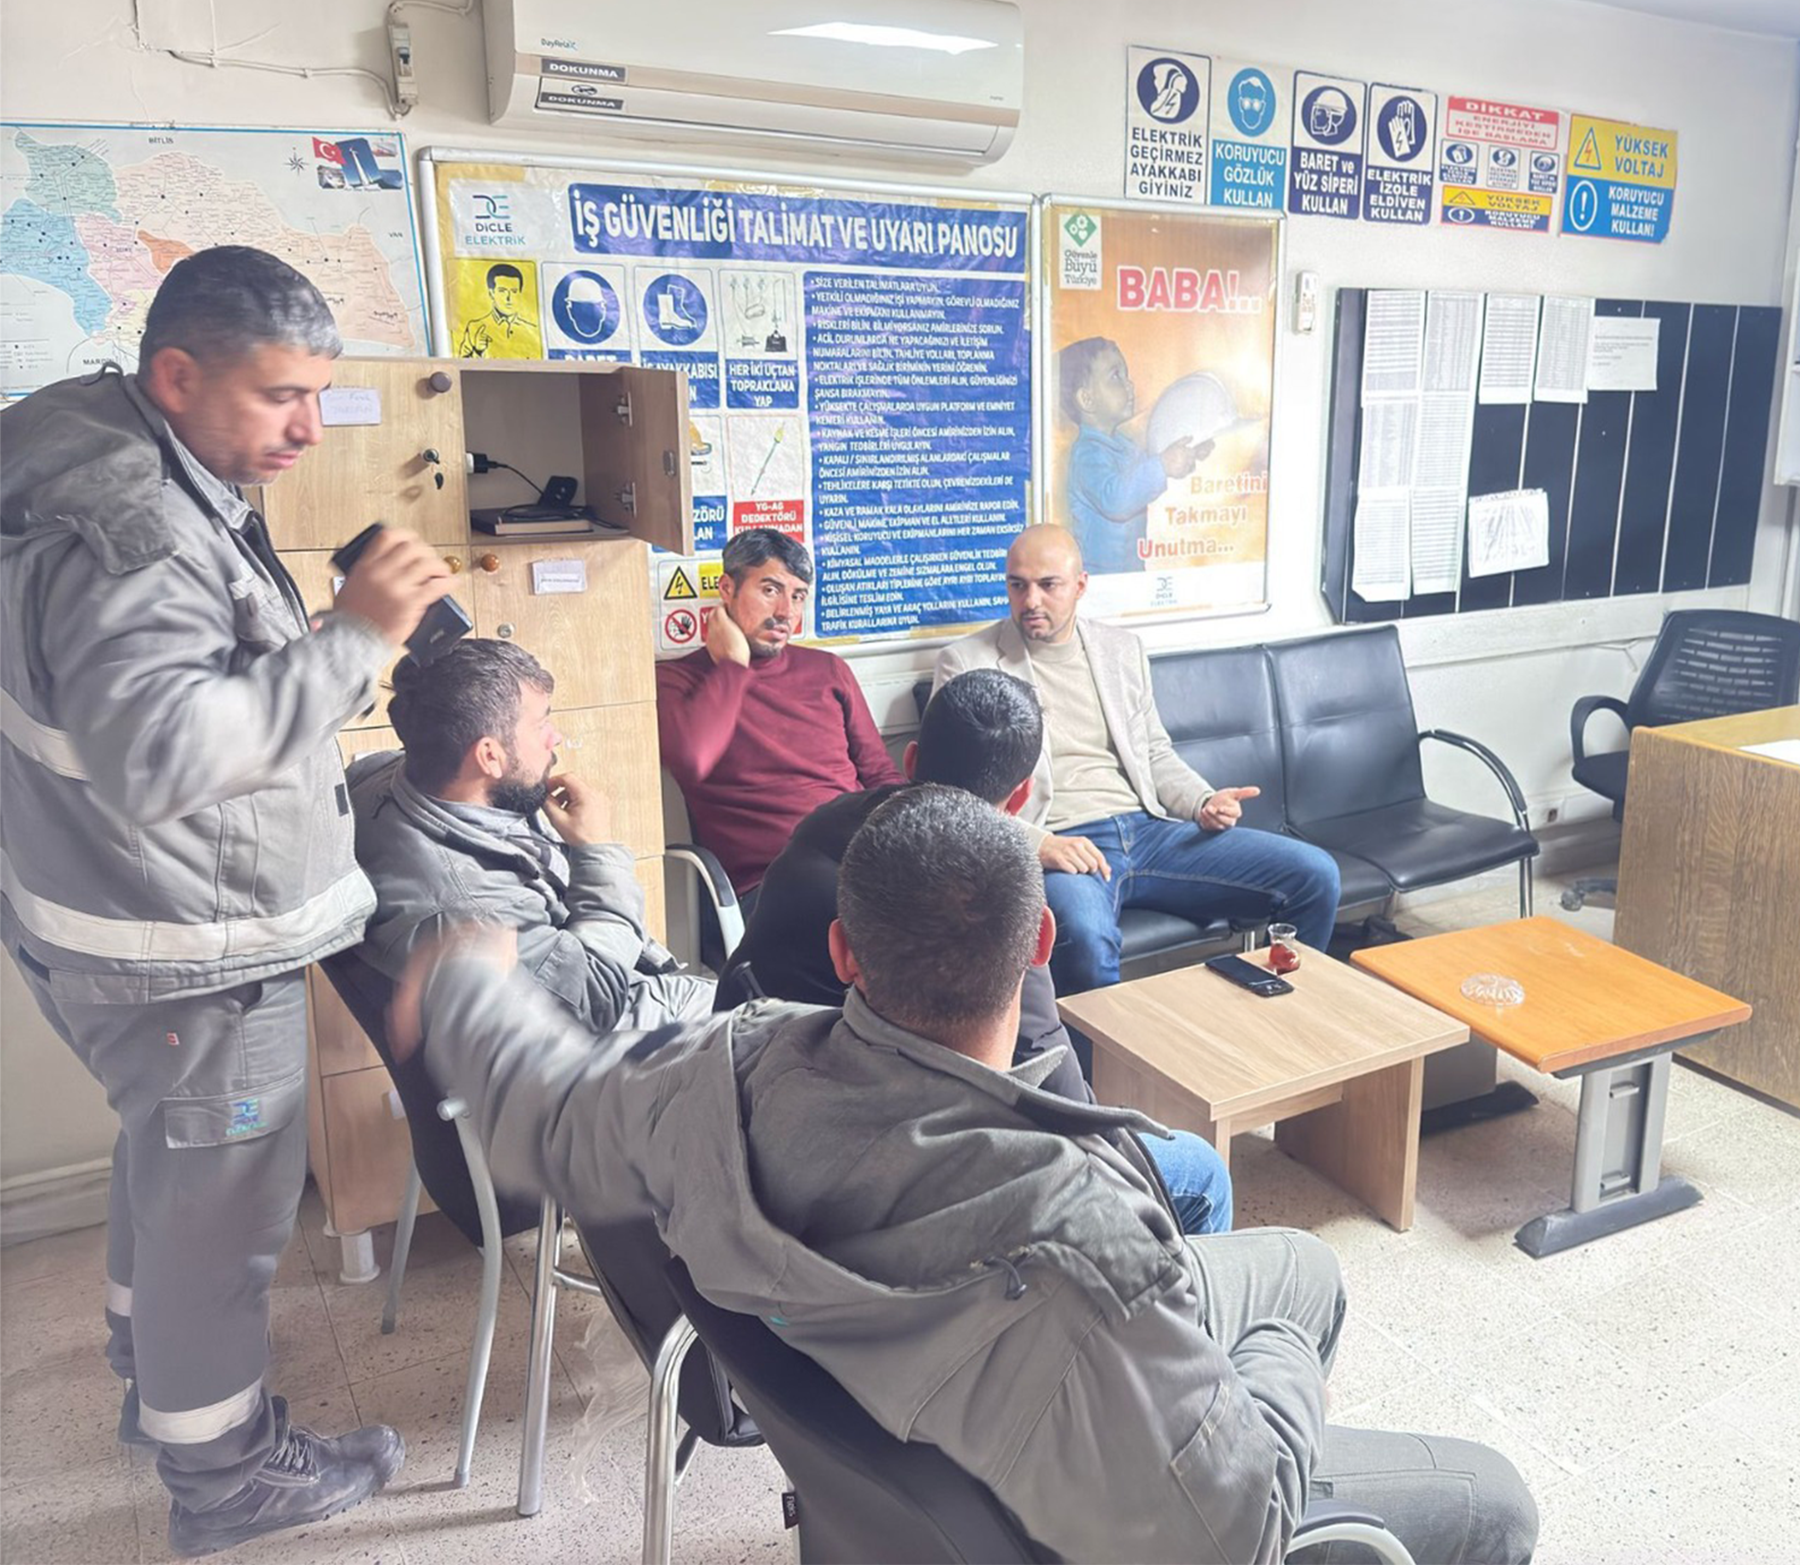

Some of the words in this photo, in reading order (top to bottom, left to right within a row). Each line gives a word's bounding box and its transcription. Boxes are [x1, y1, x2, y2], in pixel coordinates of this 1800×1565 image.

[550, 63, 618, 78] DOKUNMA
[548, 95, 616, 108] DOKUNMA
[1466, 101, 1545, 120] DİKKAT
[1132, 127, 1202, 148] ELEKTRİK
[1615, 134, 1668, 158] YÜKSEK
[1130, 144, 1202, 165] GEÇİRMEZ
[1215, 142, 1284, 165] KORUYUCU
[1301, 151, 1339, 172] BARET
[1341, 160, 1354, 174] ve
[1130, 162, 1201, 182] AYAKKABI
[1224, 163, 1274, 187] GÖZLÜK
[1367, 169, 1431, 185] ELEKTRİK
[1615, 157, 1664, 178] VOLTAJ
[1139, 178, 1192, 198] GİYİNİZ
[1294, 170, 1318, 190] YÜZ
[1321, 172, 1358, 195] SİPERİ
[1380, 181, 1418, 196] İZOLE
[1223, 188, 1273, 208] KULLAN
[1302, 194, 1348, 215] KULLAN
[1370, 194, 1425, 209] ELDİVEN
[1608, 185, 1664, 206] KORUYUCU
[1371, 207, 1423, 222] KULLAN
[1485, 209, 1540, 220] KORUYUCU
[1488, 202, 1538, 211] VOLTAJ
[1611, 202, 1658, 221] MALZEME
[475, 223, 512, 232] DİCLE
[573, 189, 600, 247] İŞ
[603, 193, 736, 243] GÜVENLİĞİ
[738, 202, 834, 248] TALİMAT
[837, 216, 868, 250] VE
[871, 218, 934, 254] UYARI
[937, 223, 1018, 258] PANOSU
[1488, 214, 1535, 225] MALZEME
[1611, 219, 1654, 237] KULLAN!
[465, 234, 526, 245] ELEKTRİK
[1065, 258, 1097, 275] Büyü
[730, 364, 749, 376] HER
[750, 361, 763, 376] İKİ
[764, 363, 795, 379] UÇTAN
[730, 379, 795, 392] TOPRAKLAMA
[753, 395, 773, 407] YAP
[1190, 471, 1267, 495] Baretini
[741, 510, 796, 523] DEDEKTÖRÜ
[1165, 506, 1246, 526] Takmayı
[1137, 538, 1234, 559] Unutma...
